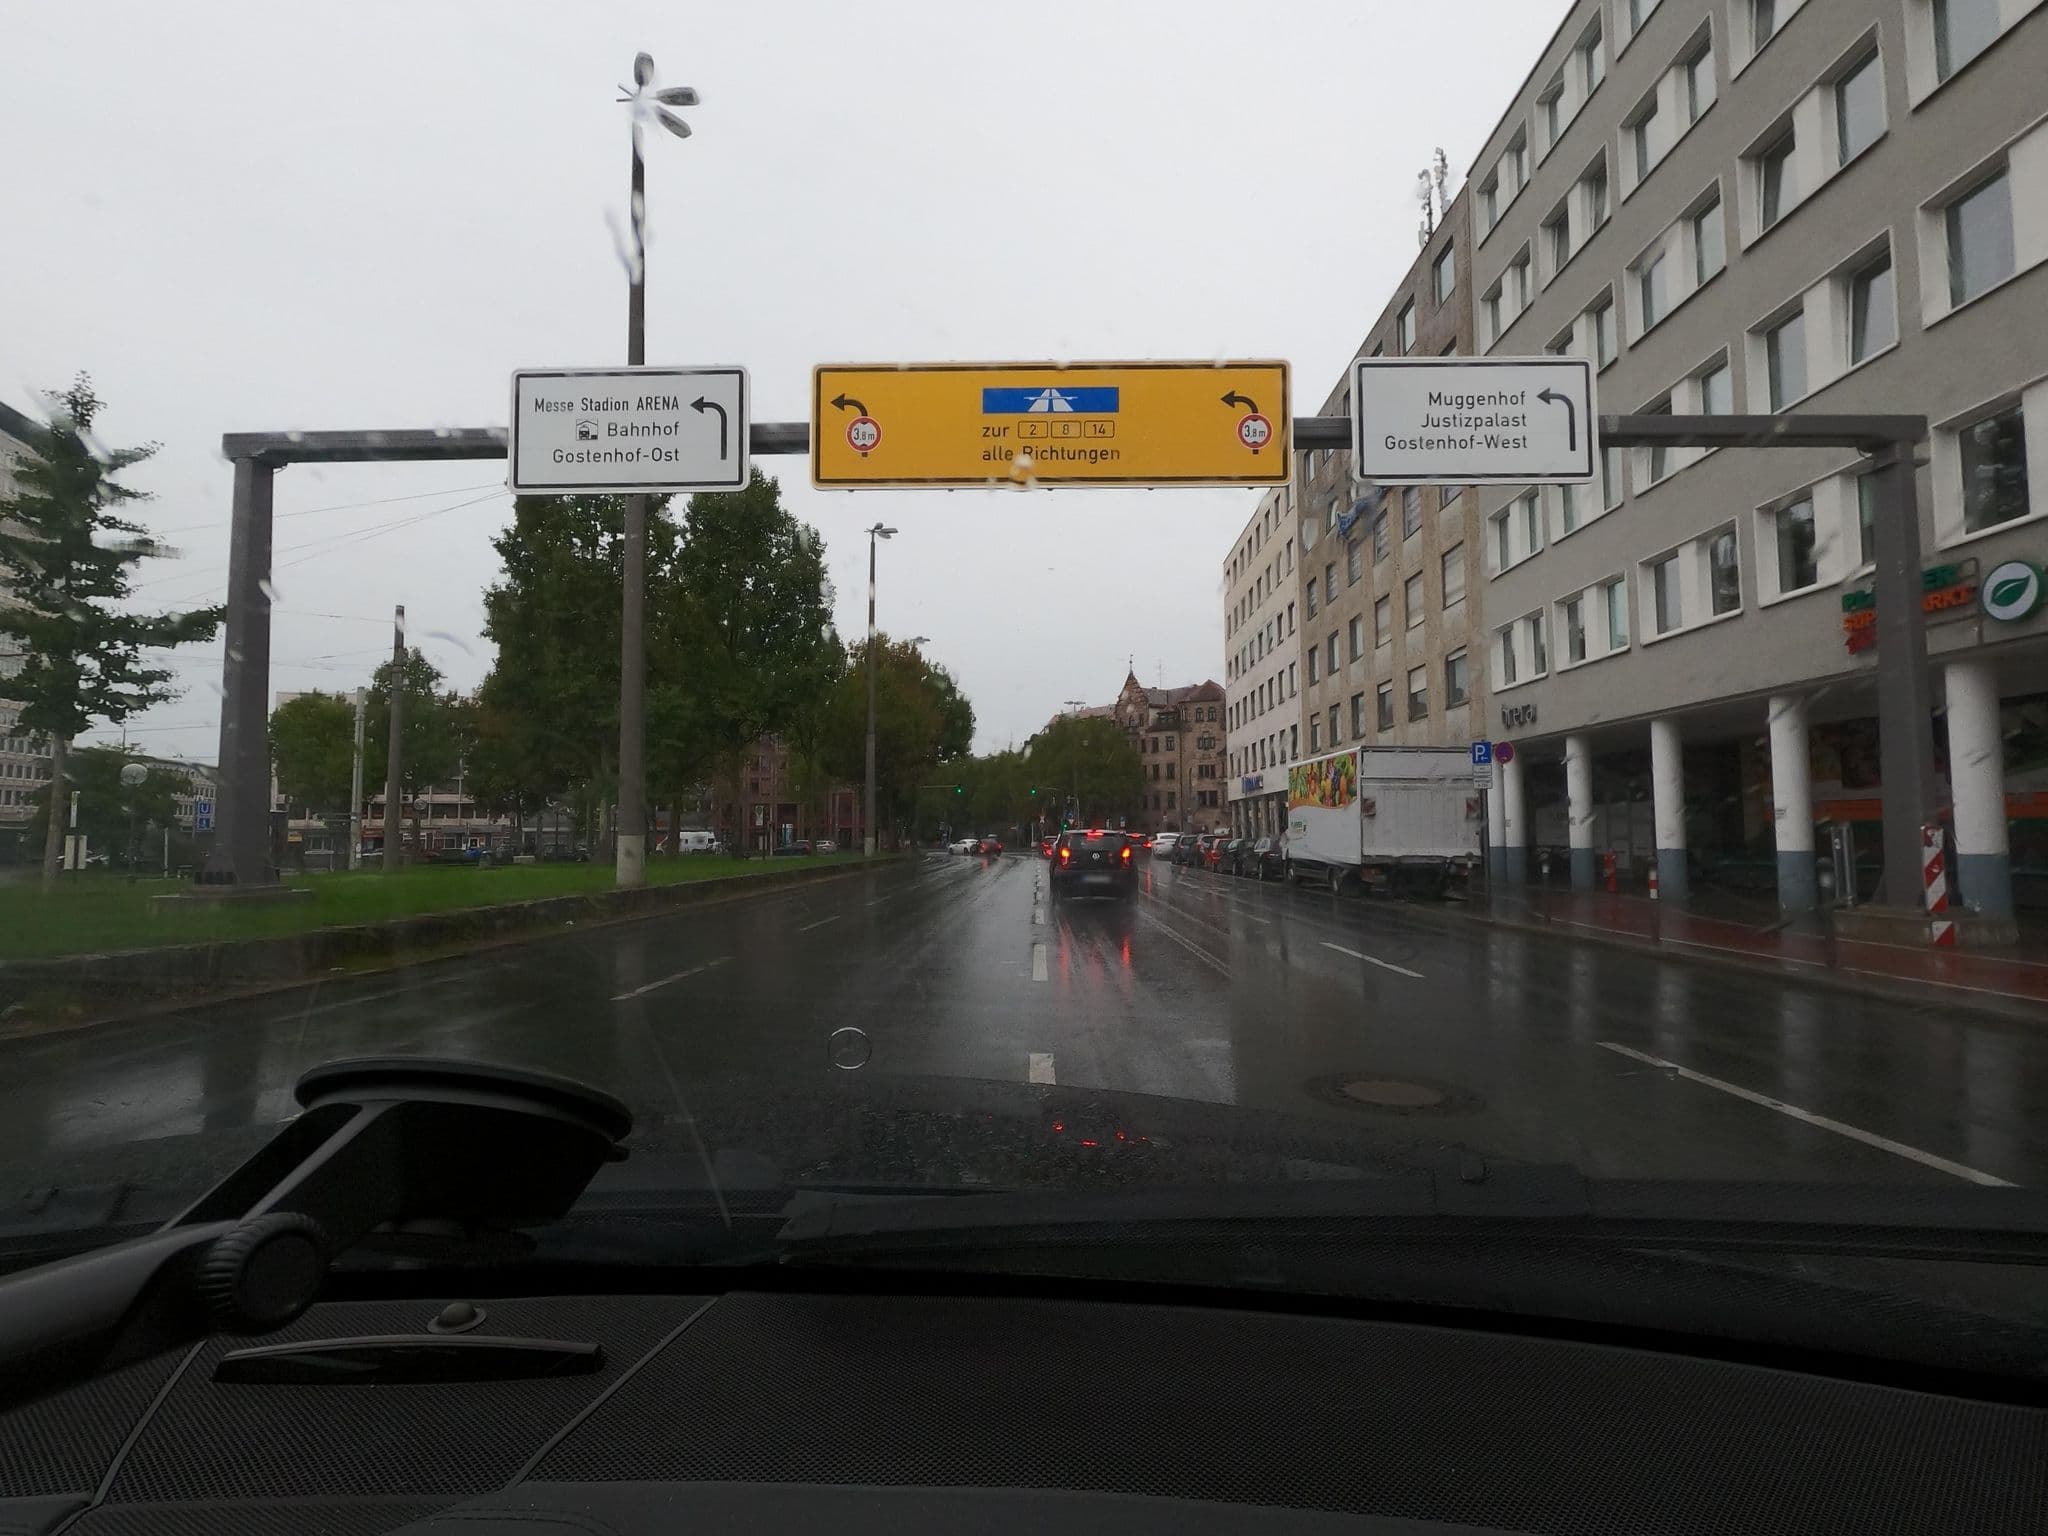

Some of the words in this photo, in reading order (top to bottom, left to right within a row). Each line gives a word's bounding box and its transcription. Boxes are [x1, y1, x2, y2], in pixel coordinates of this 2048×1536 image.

[534, 398, 574, 413] Messe
[581, 397, 629, 412] Stadion
[636, 396, 679, 411] ARENA
[1428, 391, 1526, 409] Muggenhof
[607, 421, 680, 437] Bahnhof
[1420, 413, 1527, 430] Justizpalast
[982, 426, 1010, 437] zur
[1030, 424, 1037, 436] 2
[1062, 424, 1069, 435] 8
[1093, 424, 1106, 435] 14
[1384, 434, 1528, 450] Gostenhof-West
[552, 447, 680, 463] Gostenhof-Ost
[982, 445, 1014, 461] alle
[1022, 445, 1120, 464] Richtungen
[1475, 745, 1486, 761] P
